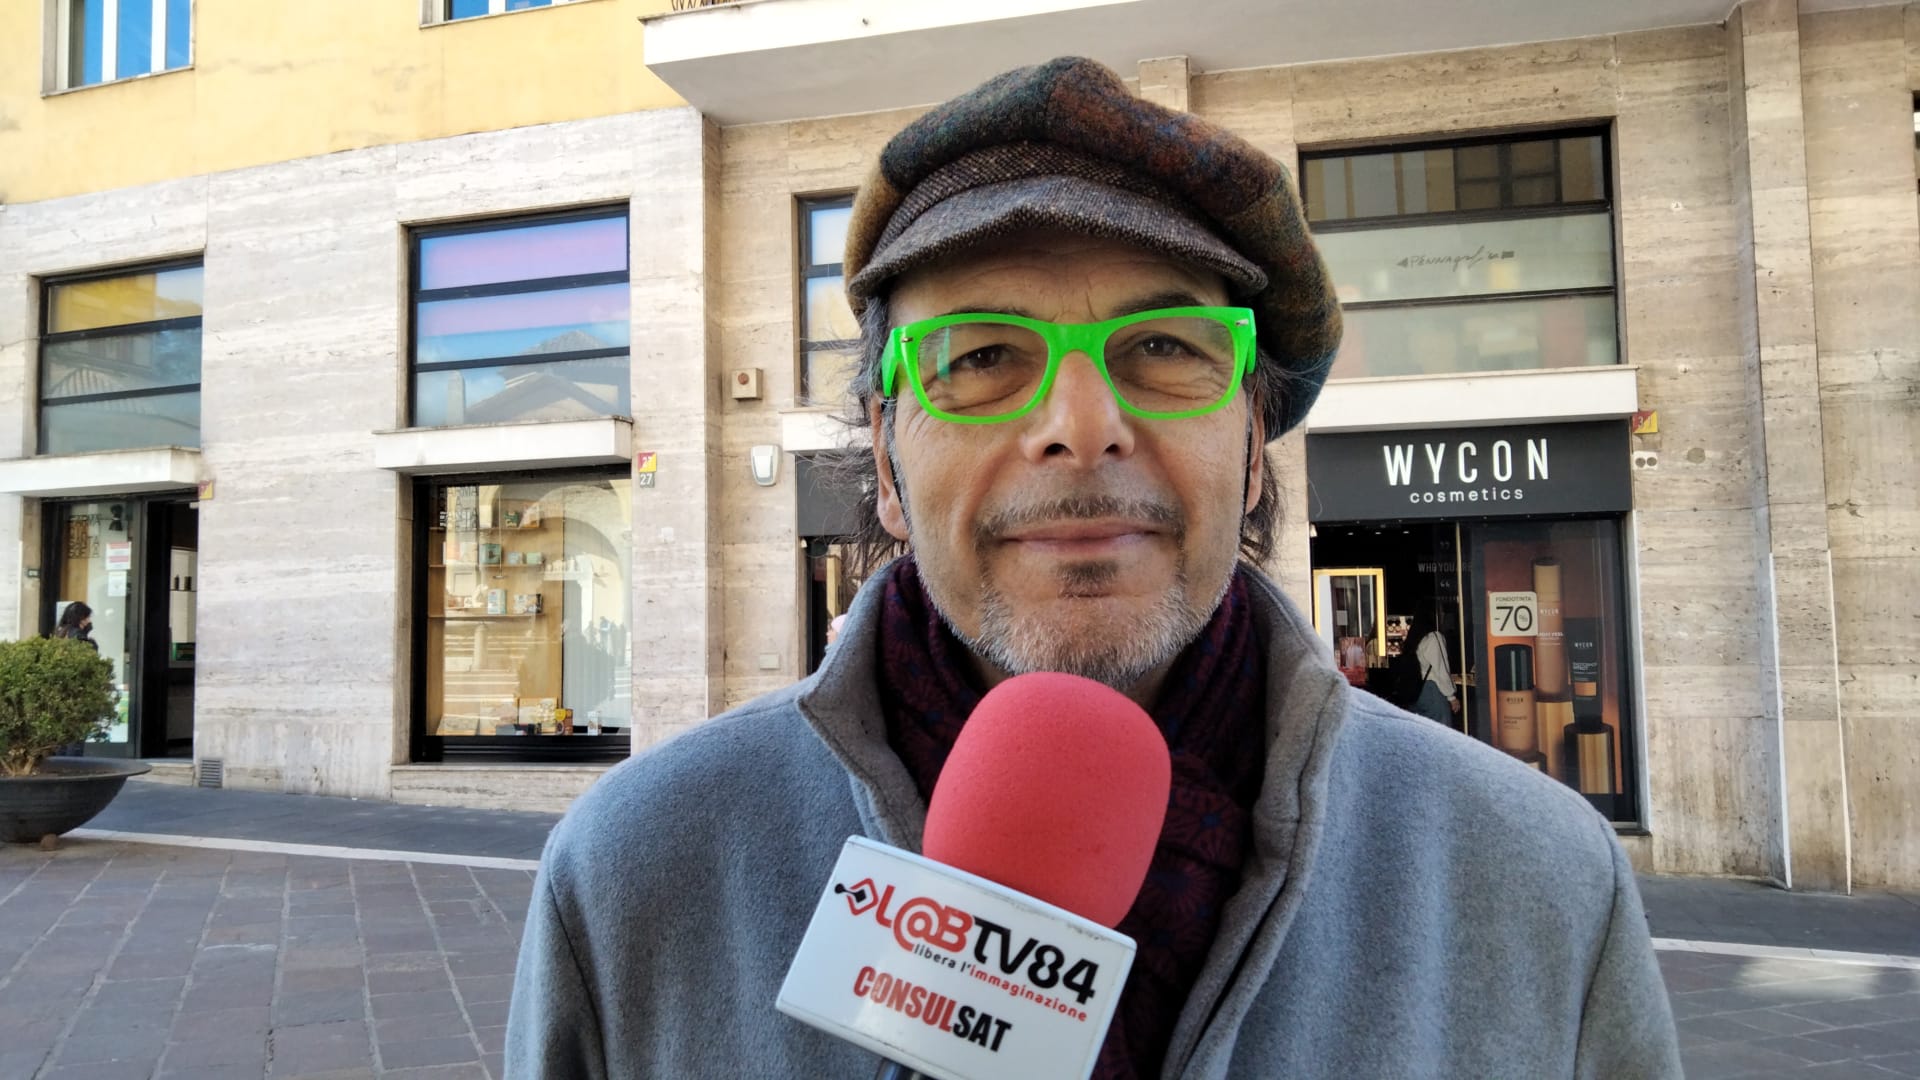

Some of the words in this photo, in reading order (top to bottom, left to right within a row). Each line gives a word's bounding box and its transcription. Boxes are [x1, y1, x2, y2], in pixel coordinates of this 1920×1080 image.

[1383, 438, 1550, 486] WYCON
[640, 473, 653, 485] 27
[1409, 487, 1524, 504] cosmetics
[1438, 562, 1455, 572] YOU
[913, 943, 956, 969] libera
[961, 961, 1088, 1022] l'immaginazione
[853, 966, 1012, 1052] CONSULSAT
